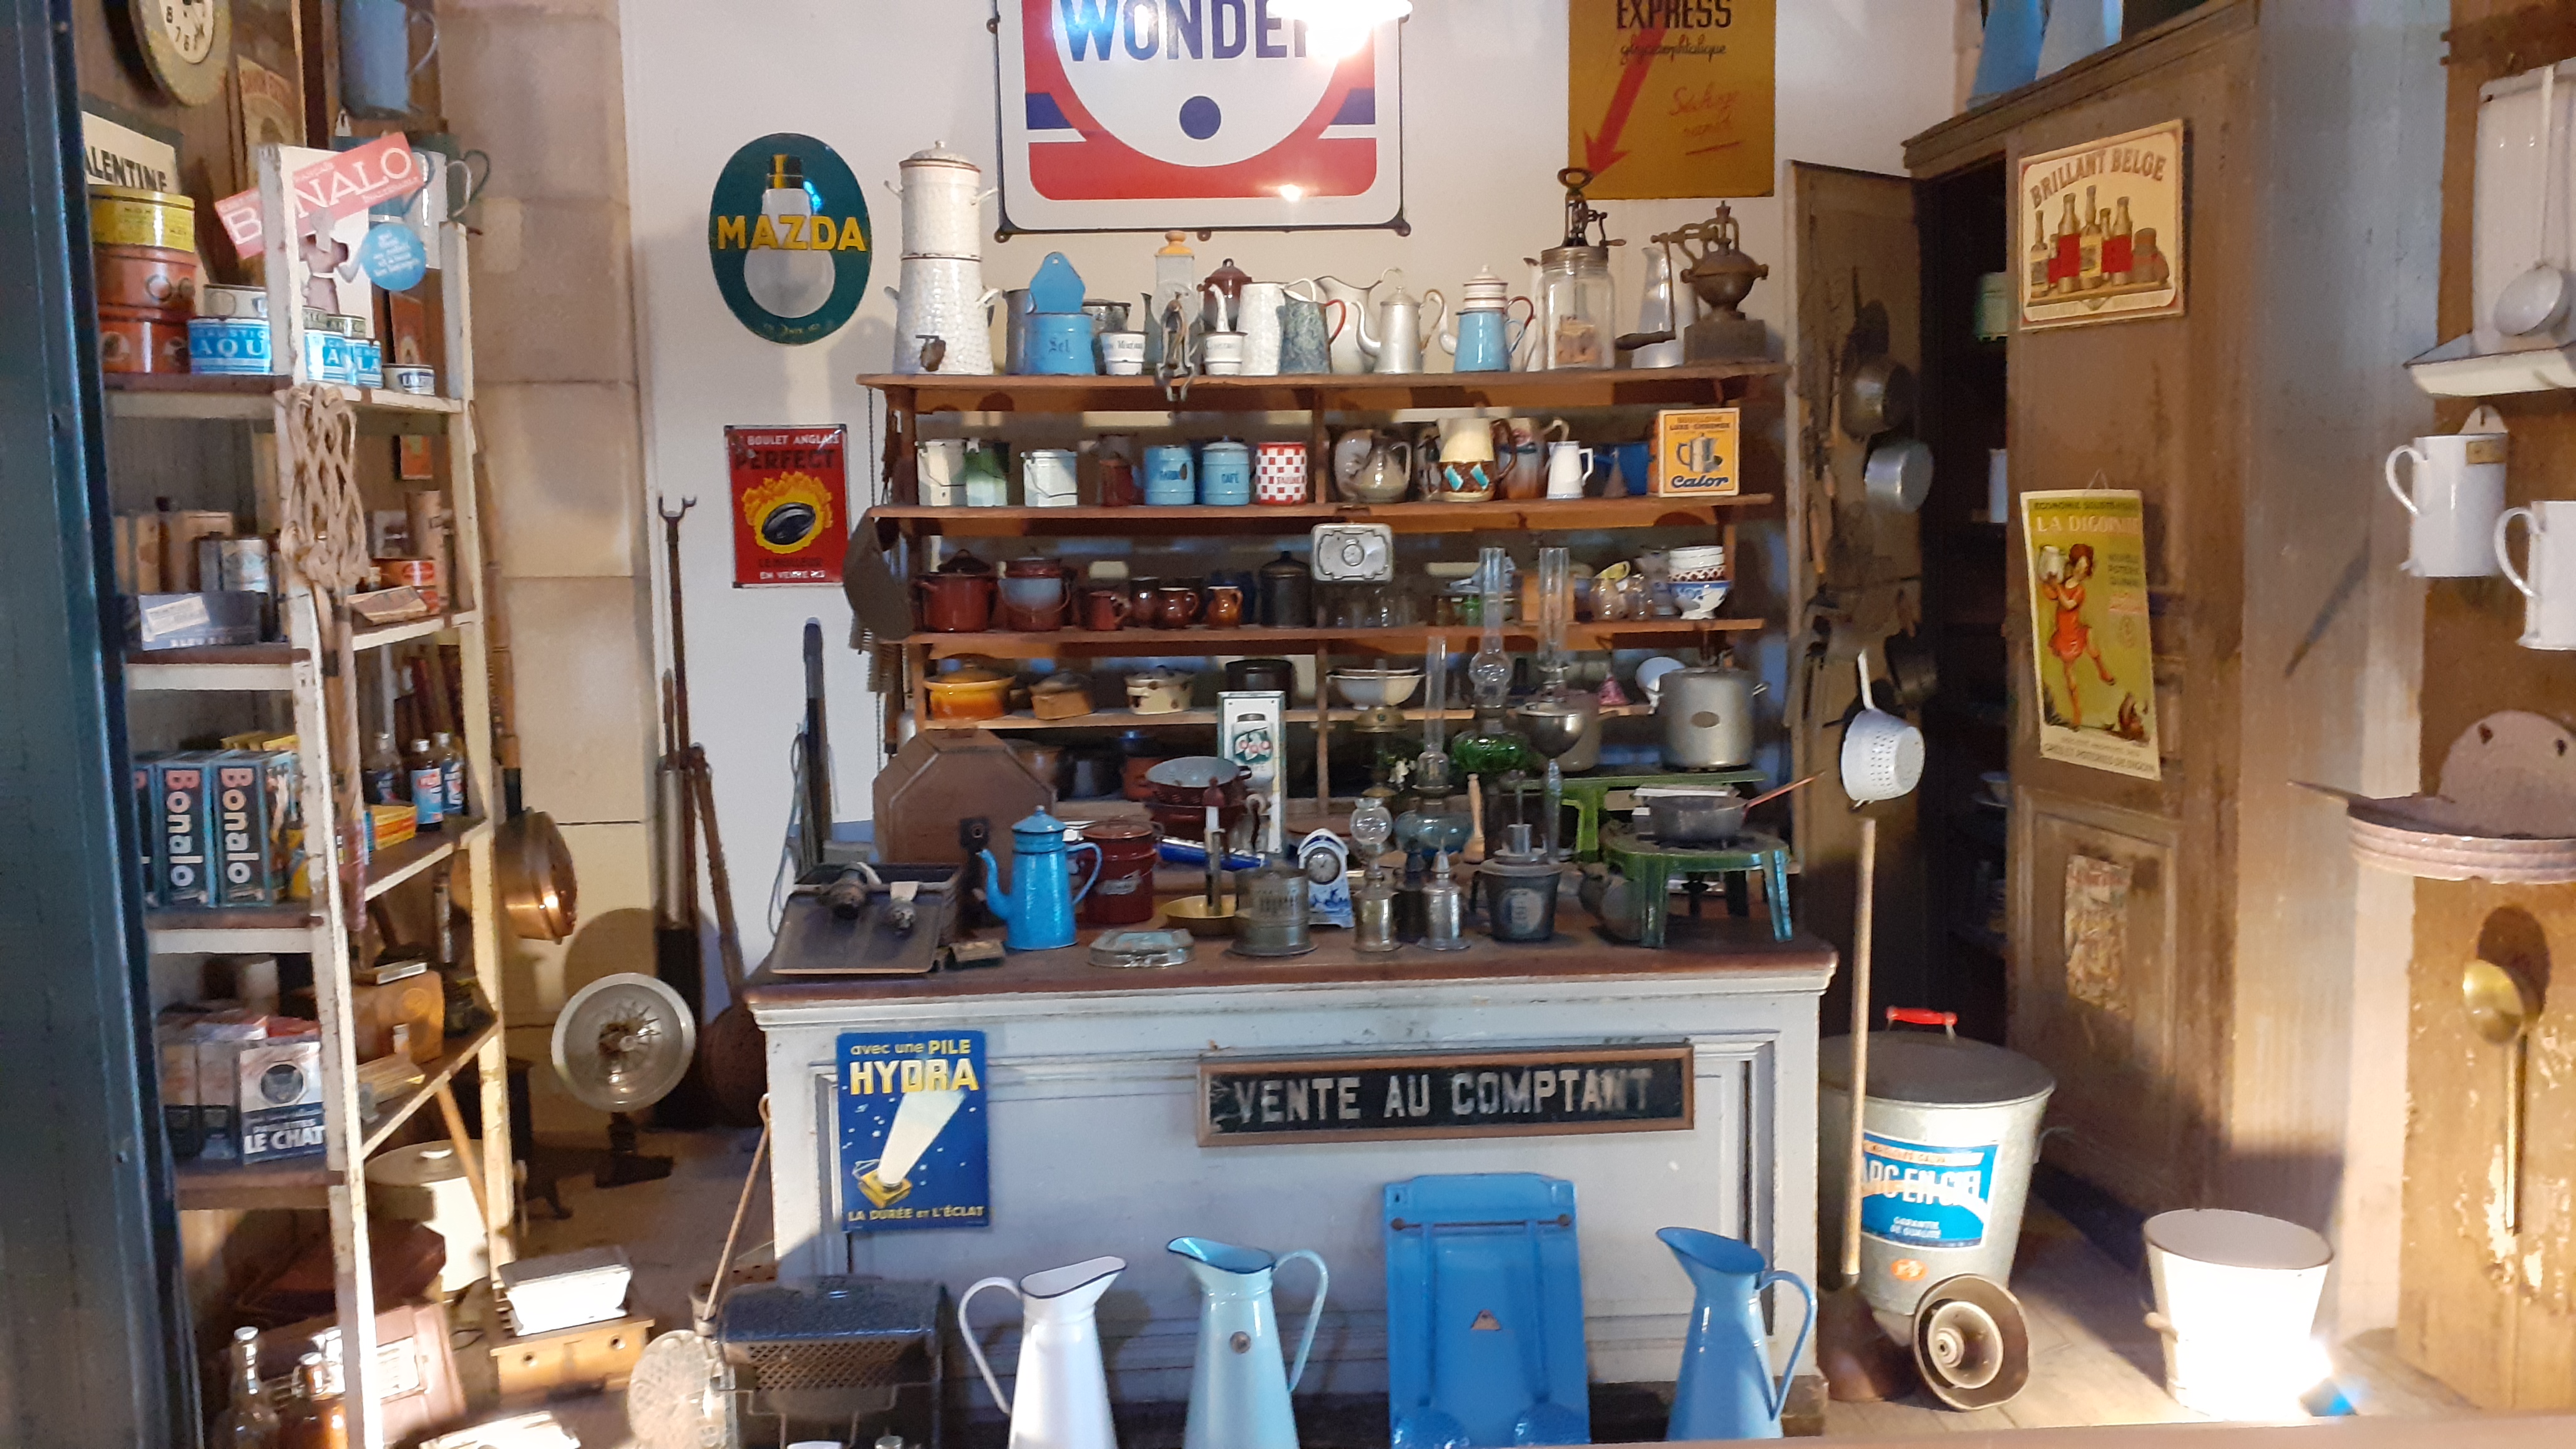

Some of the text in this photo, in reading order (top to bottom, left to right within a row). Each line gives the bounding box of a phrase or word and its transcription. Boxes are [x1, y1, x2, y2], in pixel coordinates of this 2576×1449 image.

[1617, 0, 1732, 29] EXPRESS
[2030, 147, 2167, 209] BRILLANT BELGE
[224, 147, 412, 245] BNALO
[717, 215, 867, 251] MAZDA
[748, 435, 789, 445] BOULET
[735, 449, 834, 470] PERFECT
[1671, 475, 1729, 488] Calor
[2036, 515, 2062, 532] LA
[165, 769, 203, 887] Bonalo
[220, 768, 260, 884] Bonalo
[851, 1039, 972, 1055] avec une PILE
[849, 1058, 979, 1095] HYDRA
[1233, 1068, 1653, 1123] VENTE AU COMPTANT
[244, 1133, 268, 1154] LE
[270, 1125, 326, 1149] CHAT
[848, 1210, 866, 1222] LA
[869, 1208, 914, 1220] DURÉE
